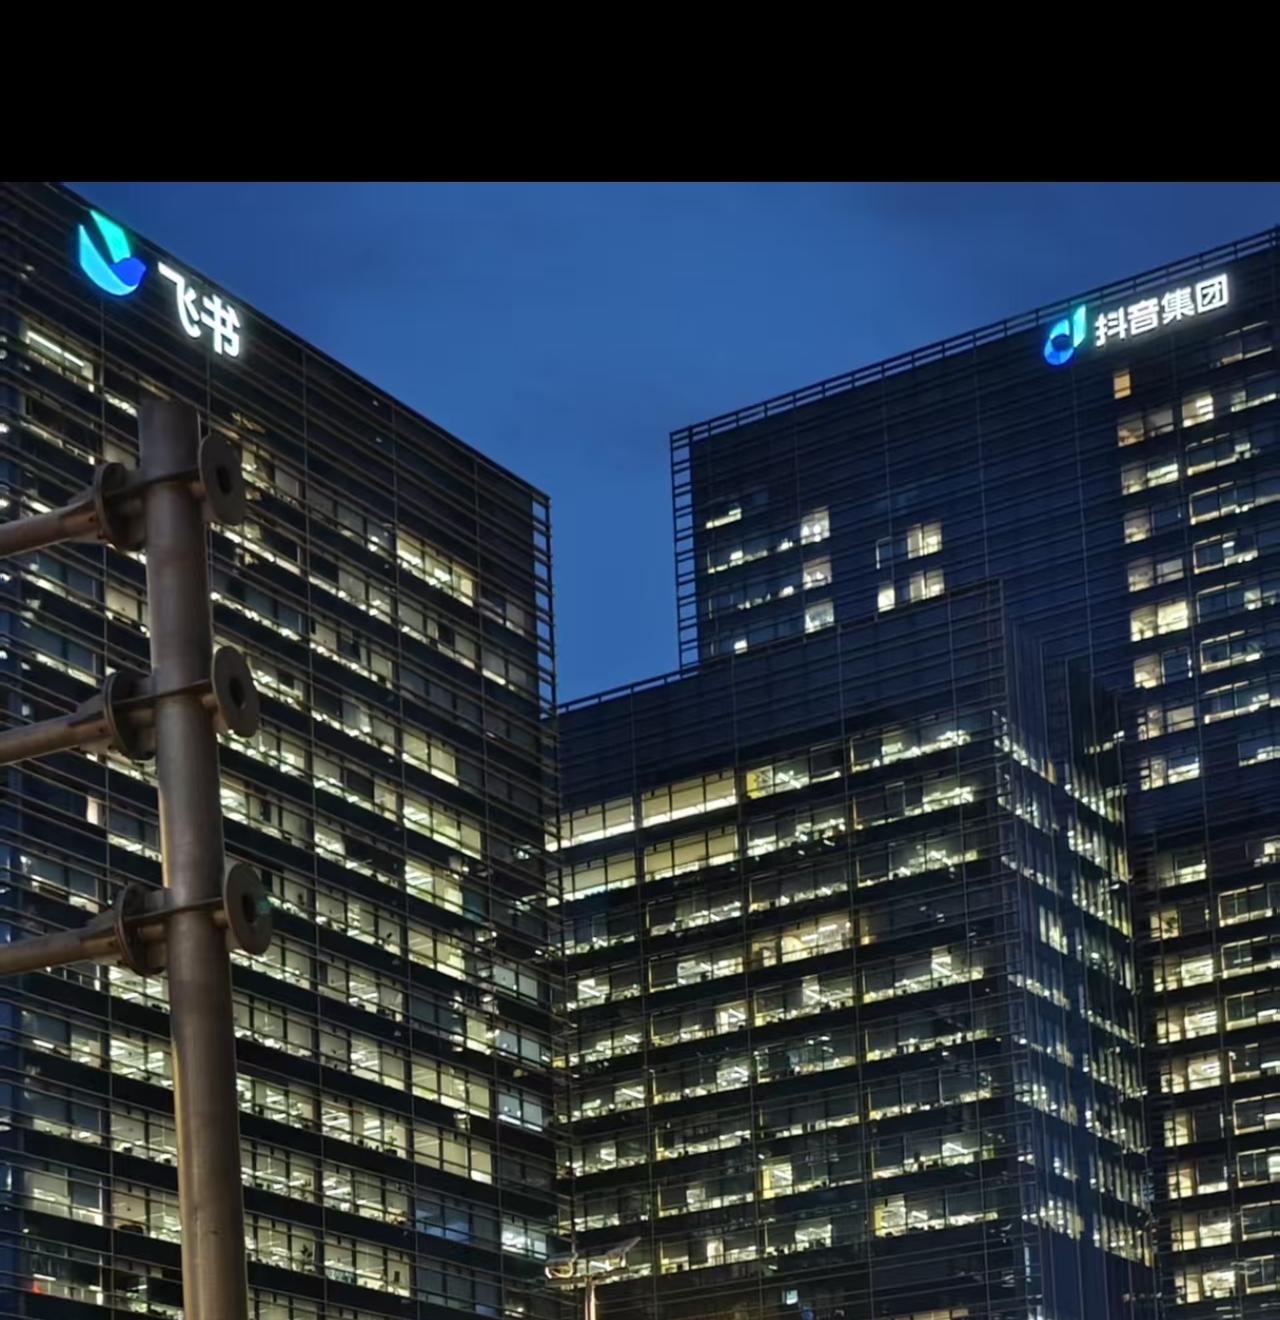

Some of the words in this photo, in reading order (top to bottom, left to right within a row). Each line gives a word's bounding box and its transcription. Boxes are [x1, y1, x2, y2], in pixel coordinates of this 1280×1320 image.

[157, 261, 241, 358] 飞书
[1093, 272, 1230, 347] 抖音集团
